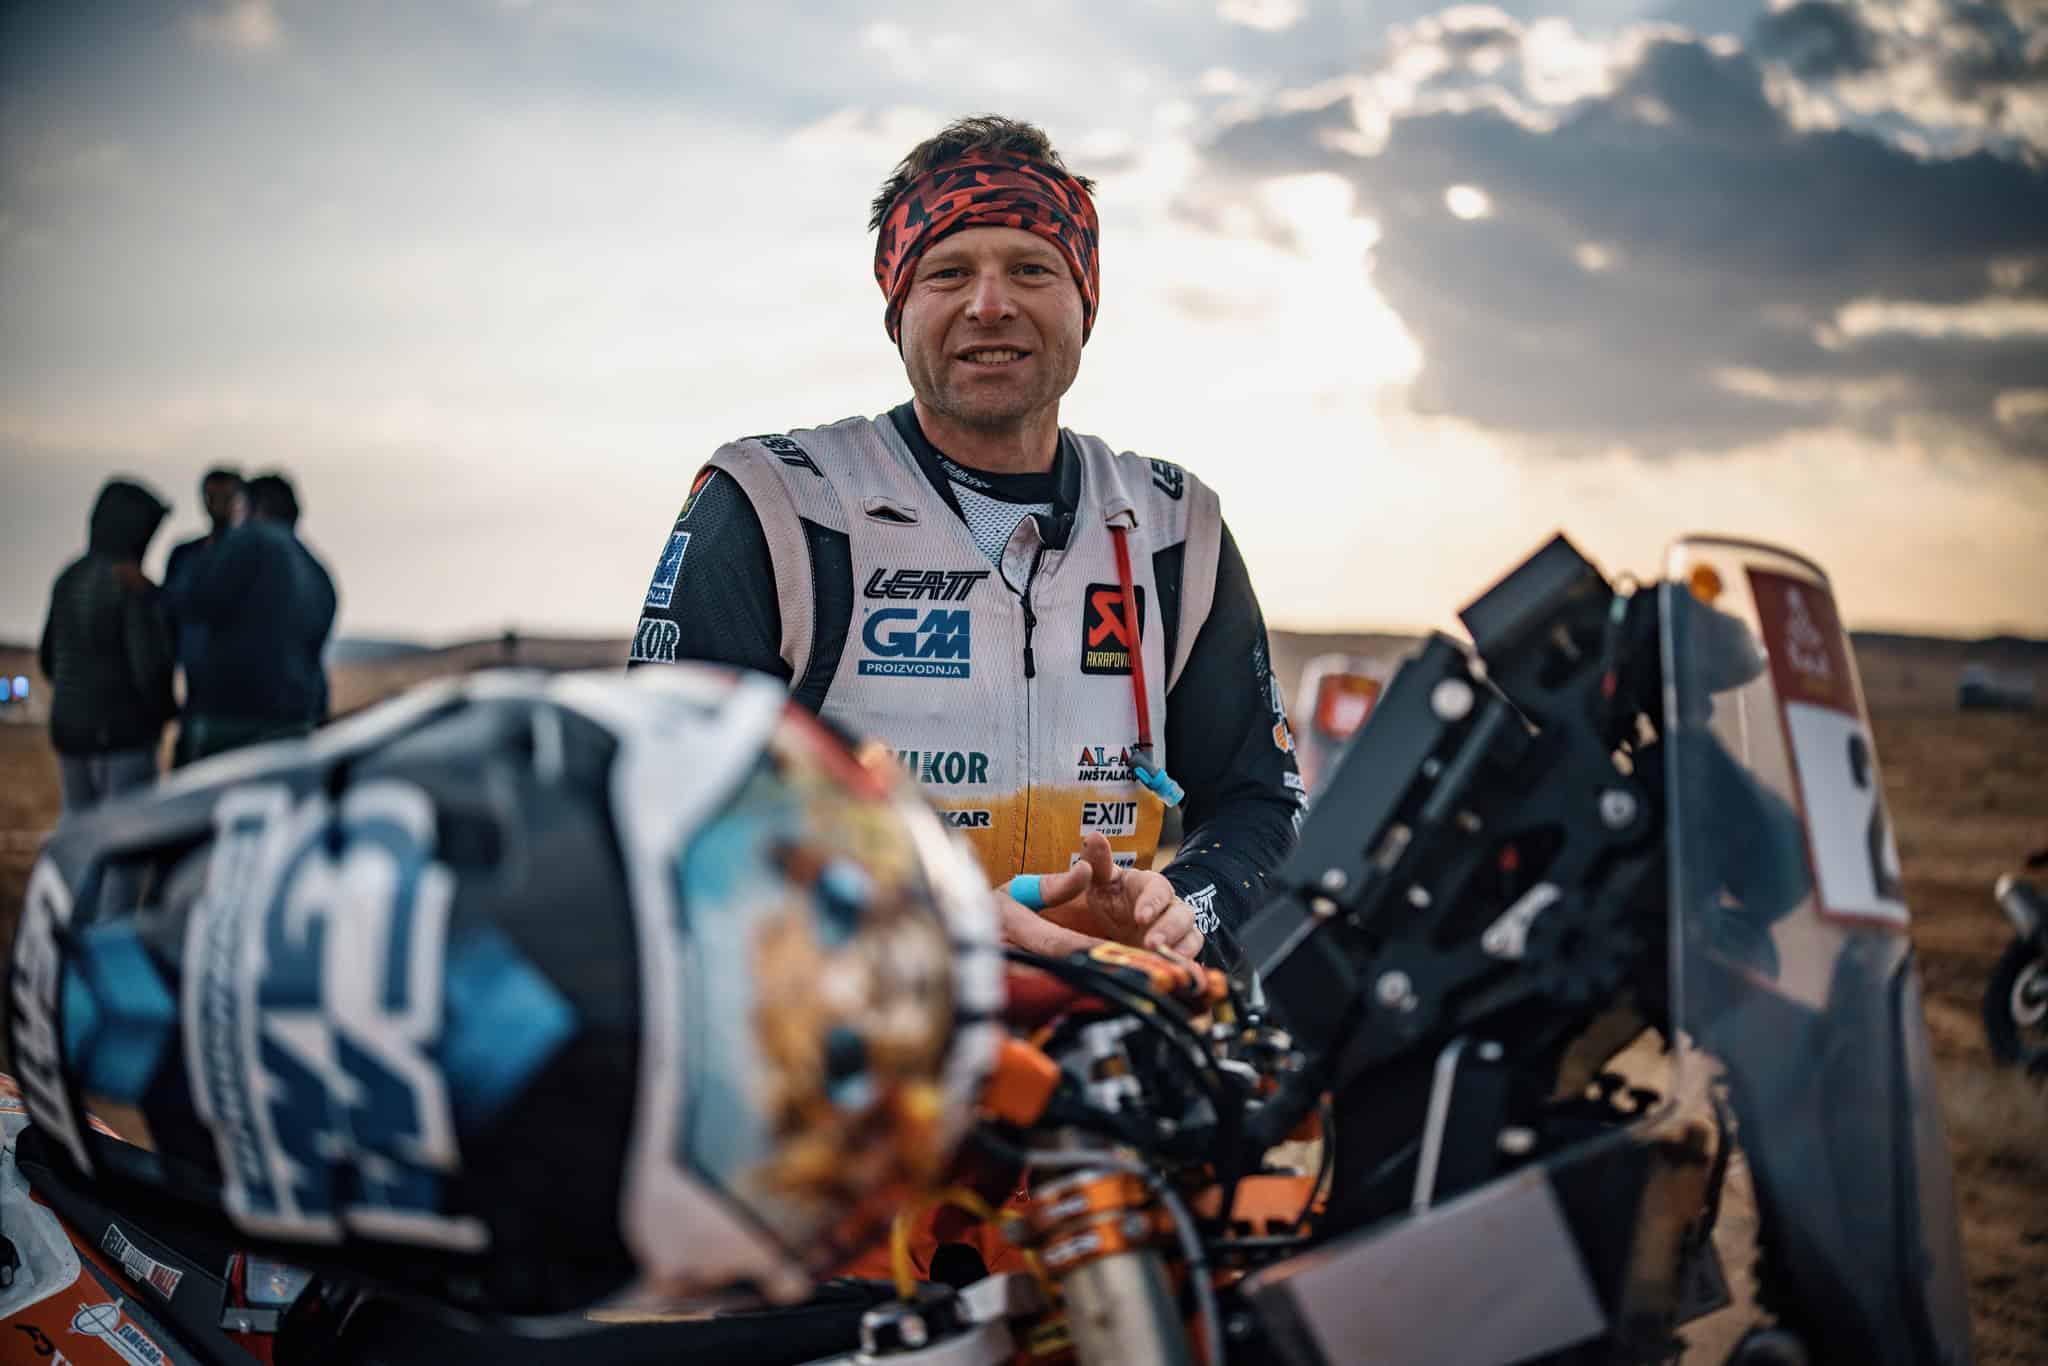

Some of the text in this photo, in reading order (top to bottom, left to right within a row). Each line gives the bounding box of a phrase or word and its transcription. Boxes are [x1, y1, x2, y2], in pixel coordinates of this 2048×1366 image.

[863, 567, 991, 601] LEATT
[863, 608, 970, 660] GM
[865, 663, 961, 675] PROIZVODNJA
[1082, 803, 1137, 825] EXIIT
